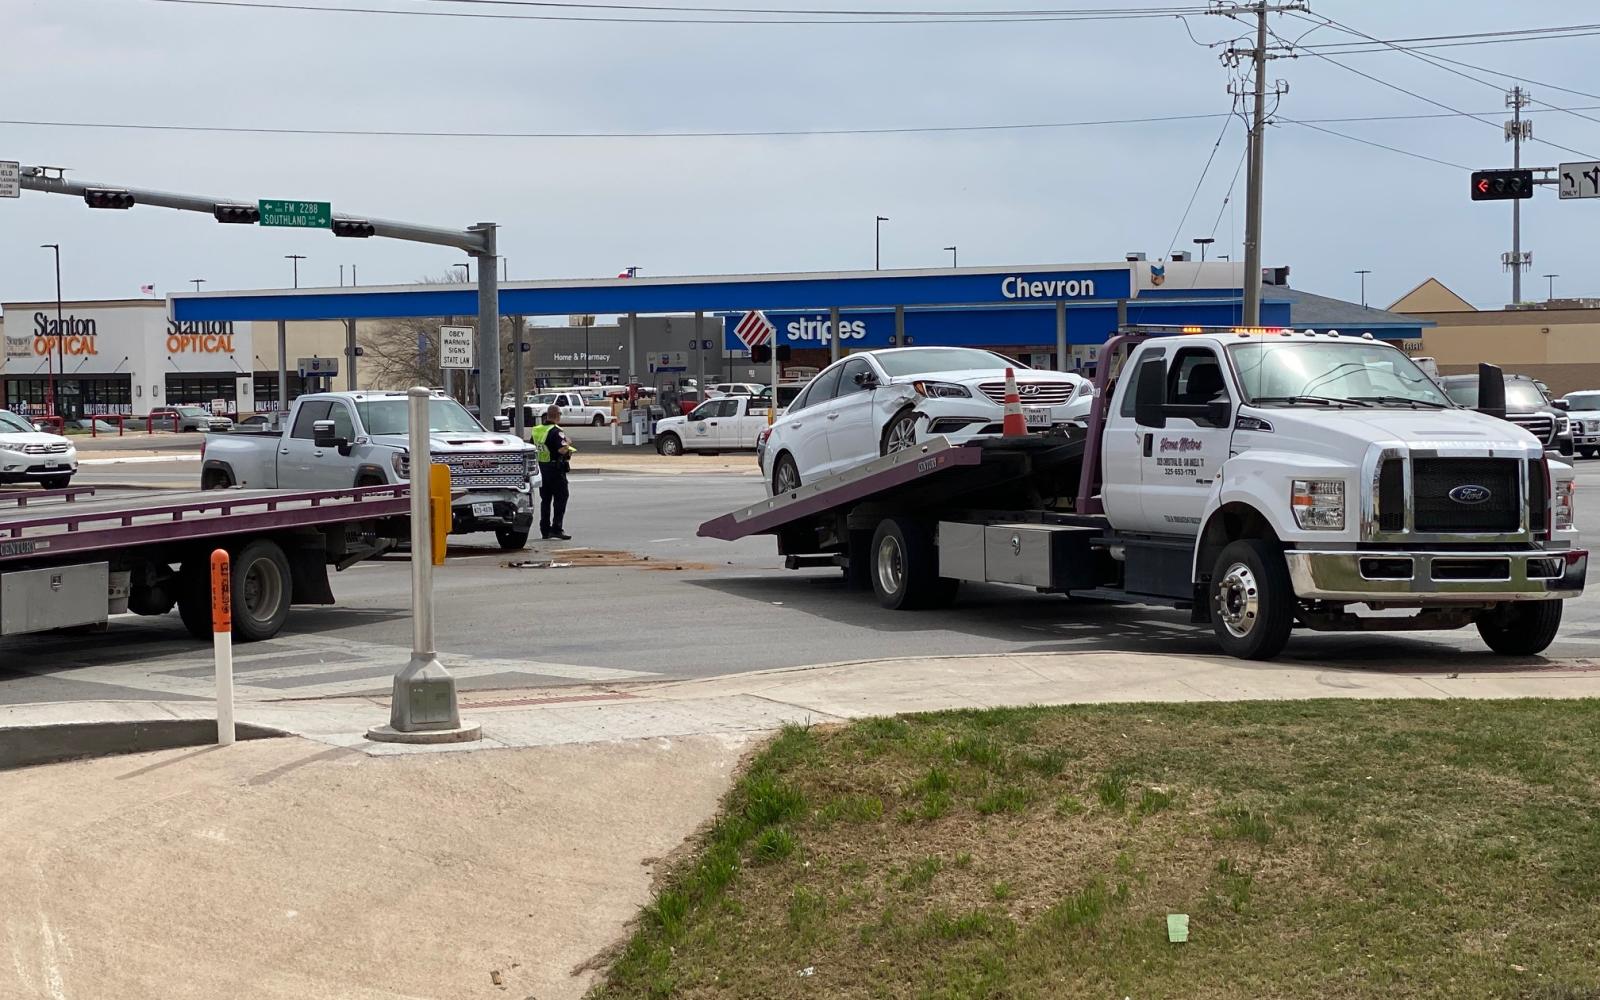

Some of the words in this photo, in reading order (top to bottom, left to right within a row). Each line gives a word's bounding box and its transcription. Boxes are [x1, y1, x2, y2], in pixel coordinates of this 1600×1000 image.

[284, 202, 295, 212] FM
[299, 203, 318, 214] 2288
[264, 214, 307, 226] SOUTHLAND
[1001, 276, 1095, 299] Chevron
[34, 312, 97, 336] Stanton
[166, 316, 234, 335] Stanton
[787, 315, 866, 345] stripes
[448, 330, 465, 338] OBEY
[34, 336, 98, 356] OPTICAL
[166, 335, 235, 353] OPTICAL
[443, 356, 459, 364] STATE
[553, 353, 572, 361] Home
[573, 352, 579, 361] &
[580, 352, 611, 362] Pharmacy
[1164, 468, 1197, 476] 325-653-1793
[1460, 487, 1483, 500] Ford
[0, 540, 36, 556] CENTURY
